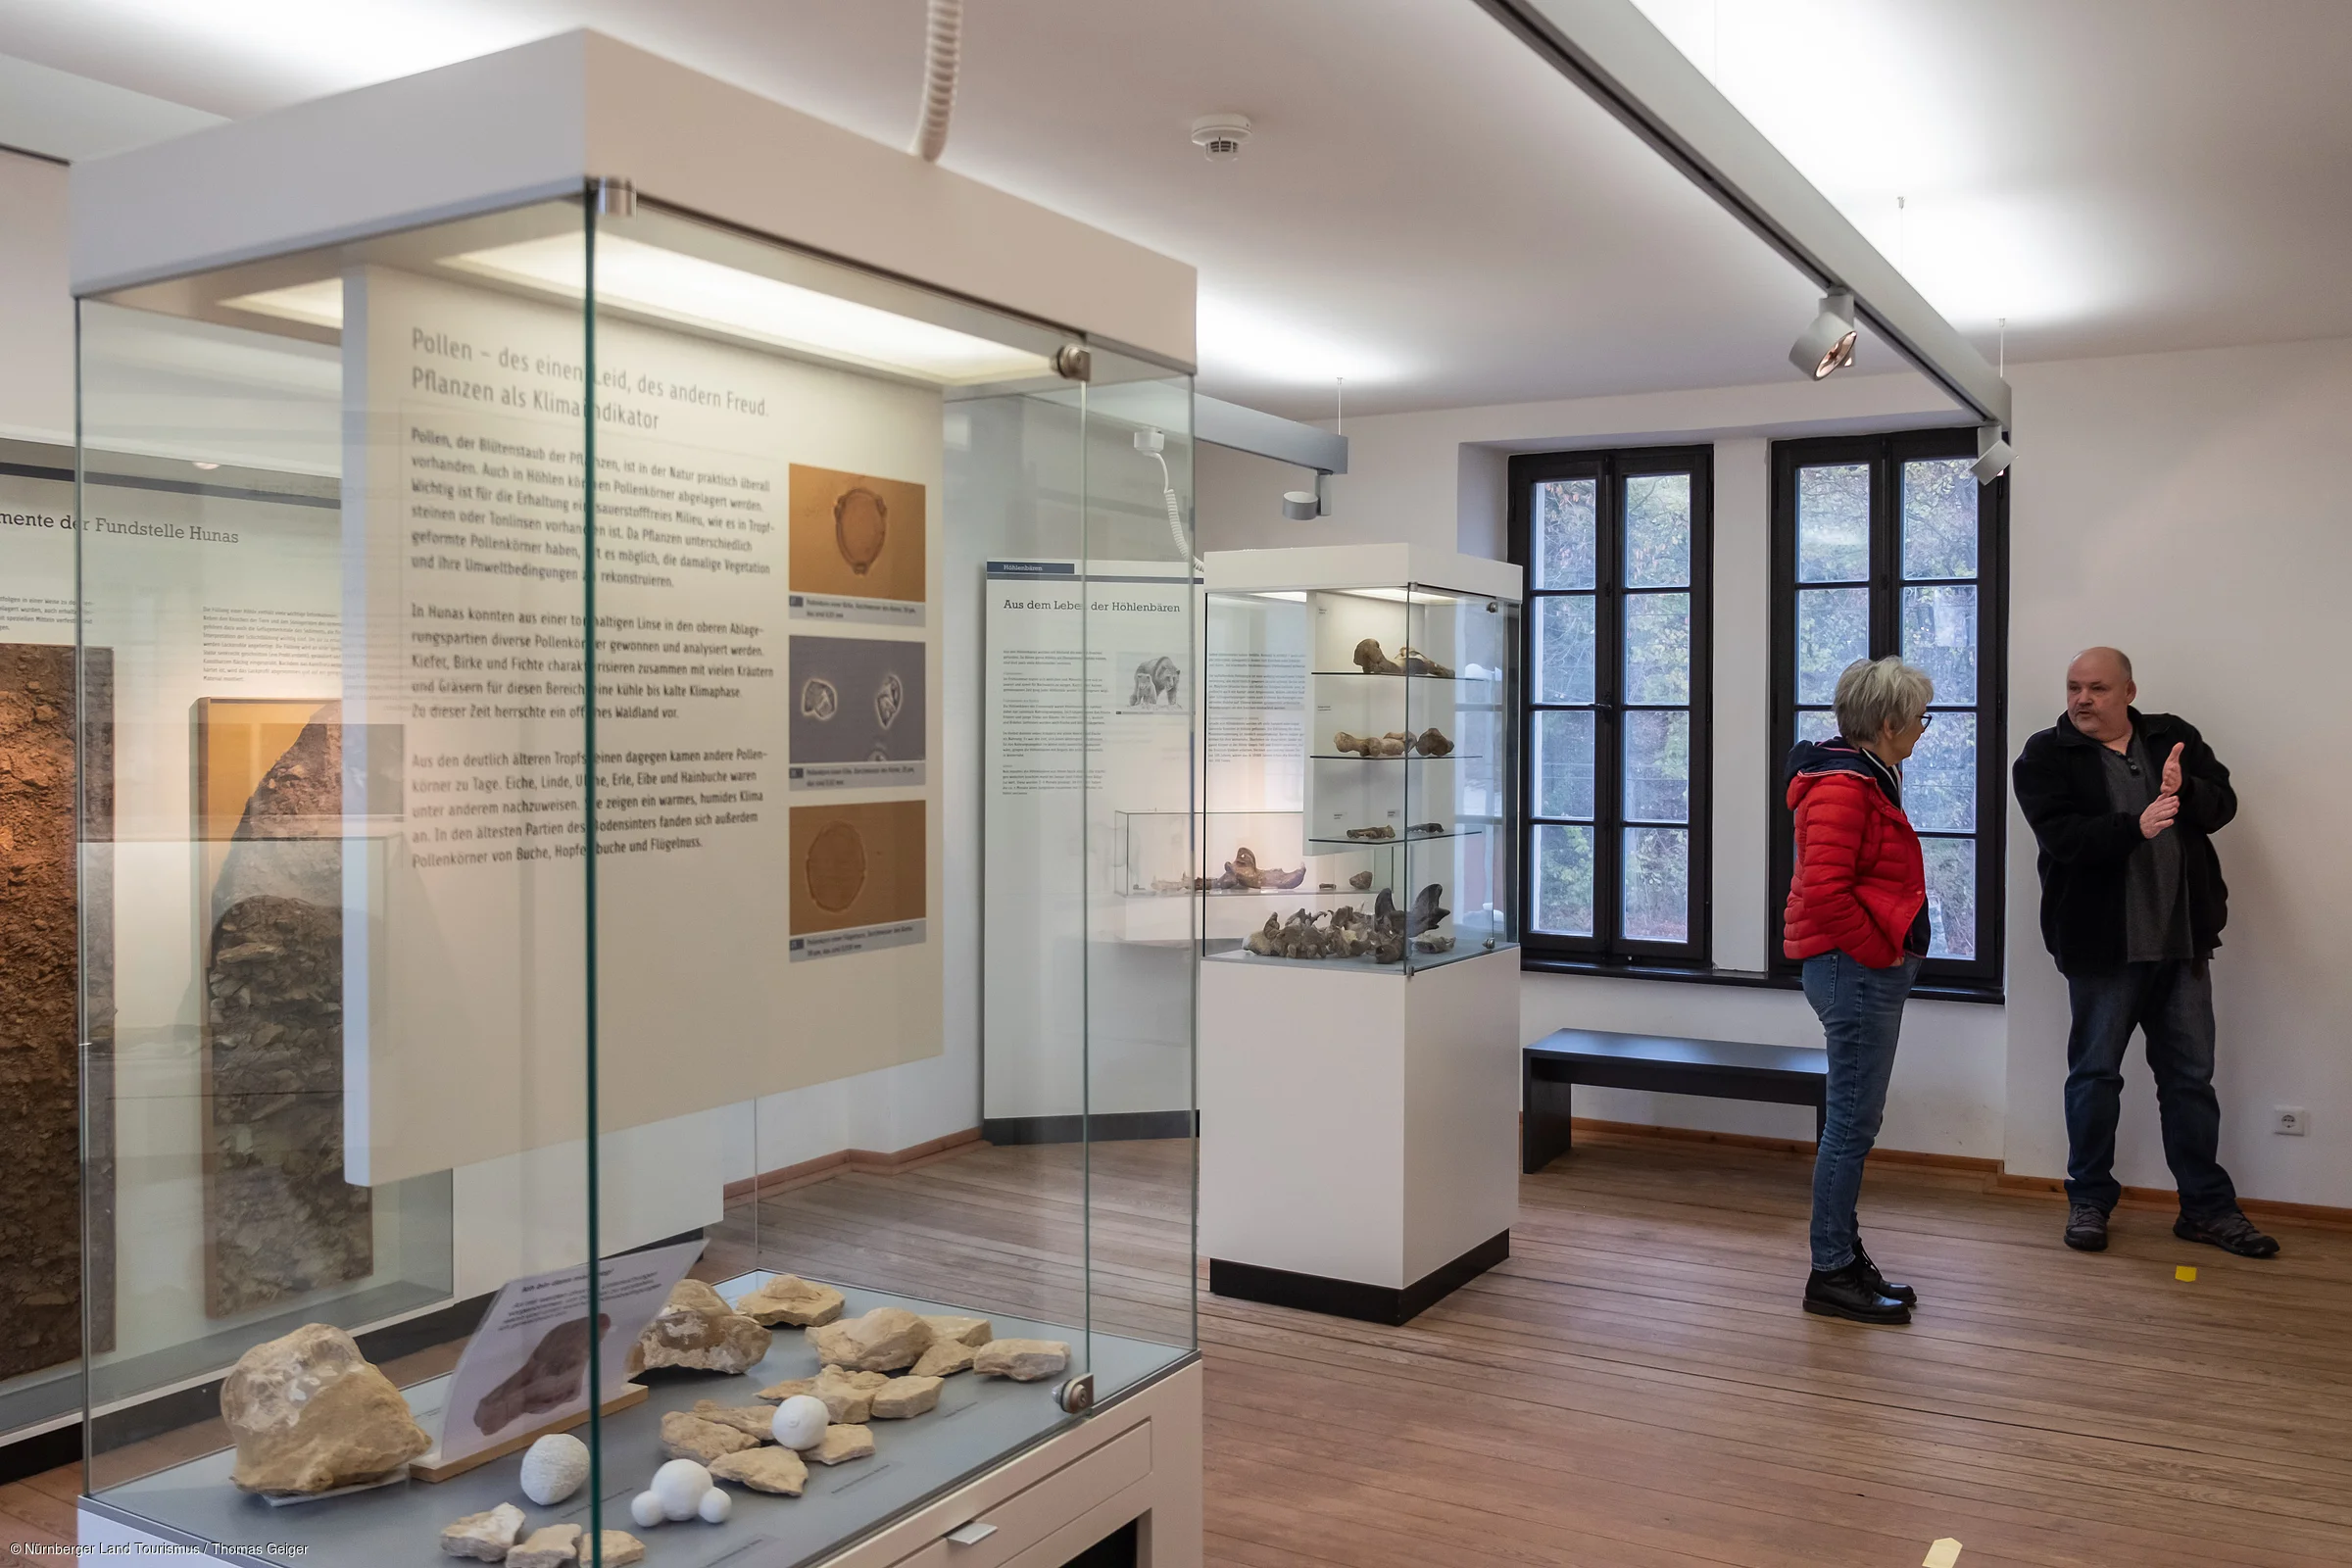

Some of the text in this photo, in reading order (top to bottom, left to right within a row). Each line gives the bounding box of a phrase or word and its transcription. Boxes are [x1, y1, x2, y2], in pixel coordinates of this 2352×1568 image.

[413, 327, 472, 361] Pollen
[499, 346, 529, 371] des
[536, 355, 583, 382] einen
[638, 374, 663, 396] des
[669, 384, 721, 408] andern
[727, 391, 769, 416] Freud.
[413, 367, 494, 402] Pflanzen
[501, 384, 526, 408] als
[412, 427, 770, 492] Pollen, der Blütenstaub der ist in der Natur praktisch überall
[412, 456, 762, 512] vorhanden. Auch in Höhlen Pollenkörner abgelagert werden.
[412, 478, 774, 534] Wichtig ist für die Erhaltung Milieu, wie es in Tropf-
[61, 515, 89, 530] der
[95, 517, 184, 538] Fundstelle
[189, 526, 238, 543] Hunas
[412, 506, 752, 552] steinen oder Tonlinsen ist. Da Pflanzen unterschiedlich
[412, 530, 770, 574] geformte Pollenkörner haben, es möglich, die damalige Vegetation
[412, 556, 674, 588] und Umweltbedingungen rekonstruieren.
[412, 603, 764, 638] In Hunas konnten aus einer Linse in den oberen Ablage-
[1004, 600, 1180, 612] Aus dem Lebe der Höhlenbären
[412, 632, 763, 657] rungspartien diverse gewonnen und analysiert werden.
[412, 655, 773, 677] Kiefer, Birke und Fichte zusammen mit vielen Kräutern
[439, 680, 482, 694] Gräsern
[487, 681, 502, 694] für
[508, 682, 542, 695] diesen
[546, 681, 585, 695] Bereich
[617, 684, 643, 696] kühle
[647, 684, 660, 697] bis
[663, 684, 687, 697] kalte
[413, 704, 678, 718] Zu dieser Zeit herrschte ein Waldland vor.
[413, 748, 768, 768] Aus den deutlich älteren dagegen kamen andere Pollen-
[412, 770, 757, 793] körner zu Tage. Eiche, Linde, Erle, Eibe und Hainbuche waren
[412, 790, 763, 818] unter anderem nachzuweisen. zeigen ein warmes, humides Klima
[412, 811, 758, 843] an. In den ältesten Partien des fanden sich außerdem
[412, 836, 703, 868] Pollenkörner von Buche, und Flügelnuss.
